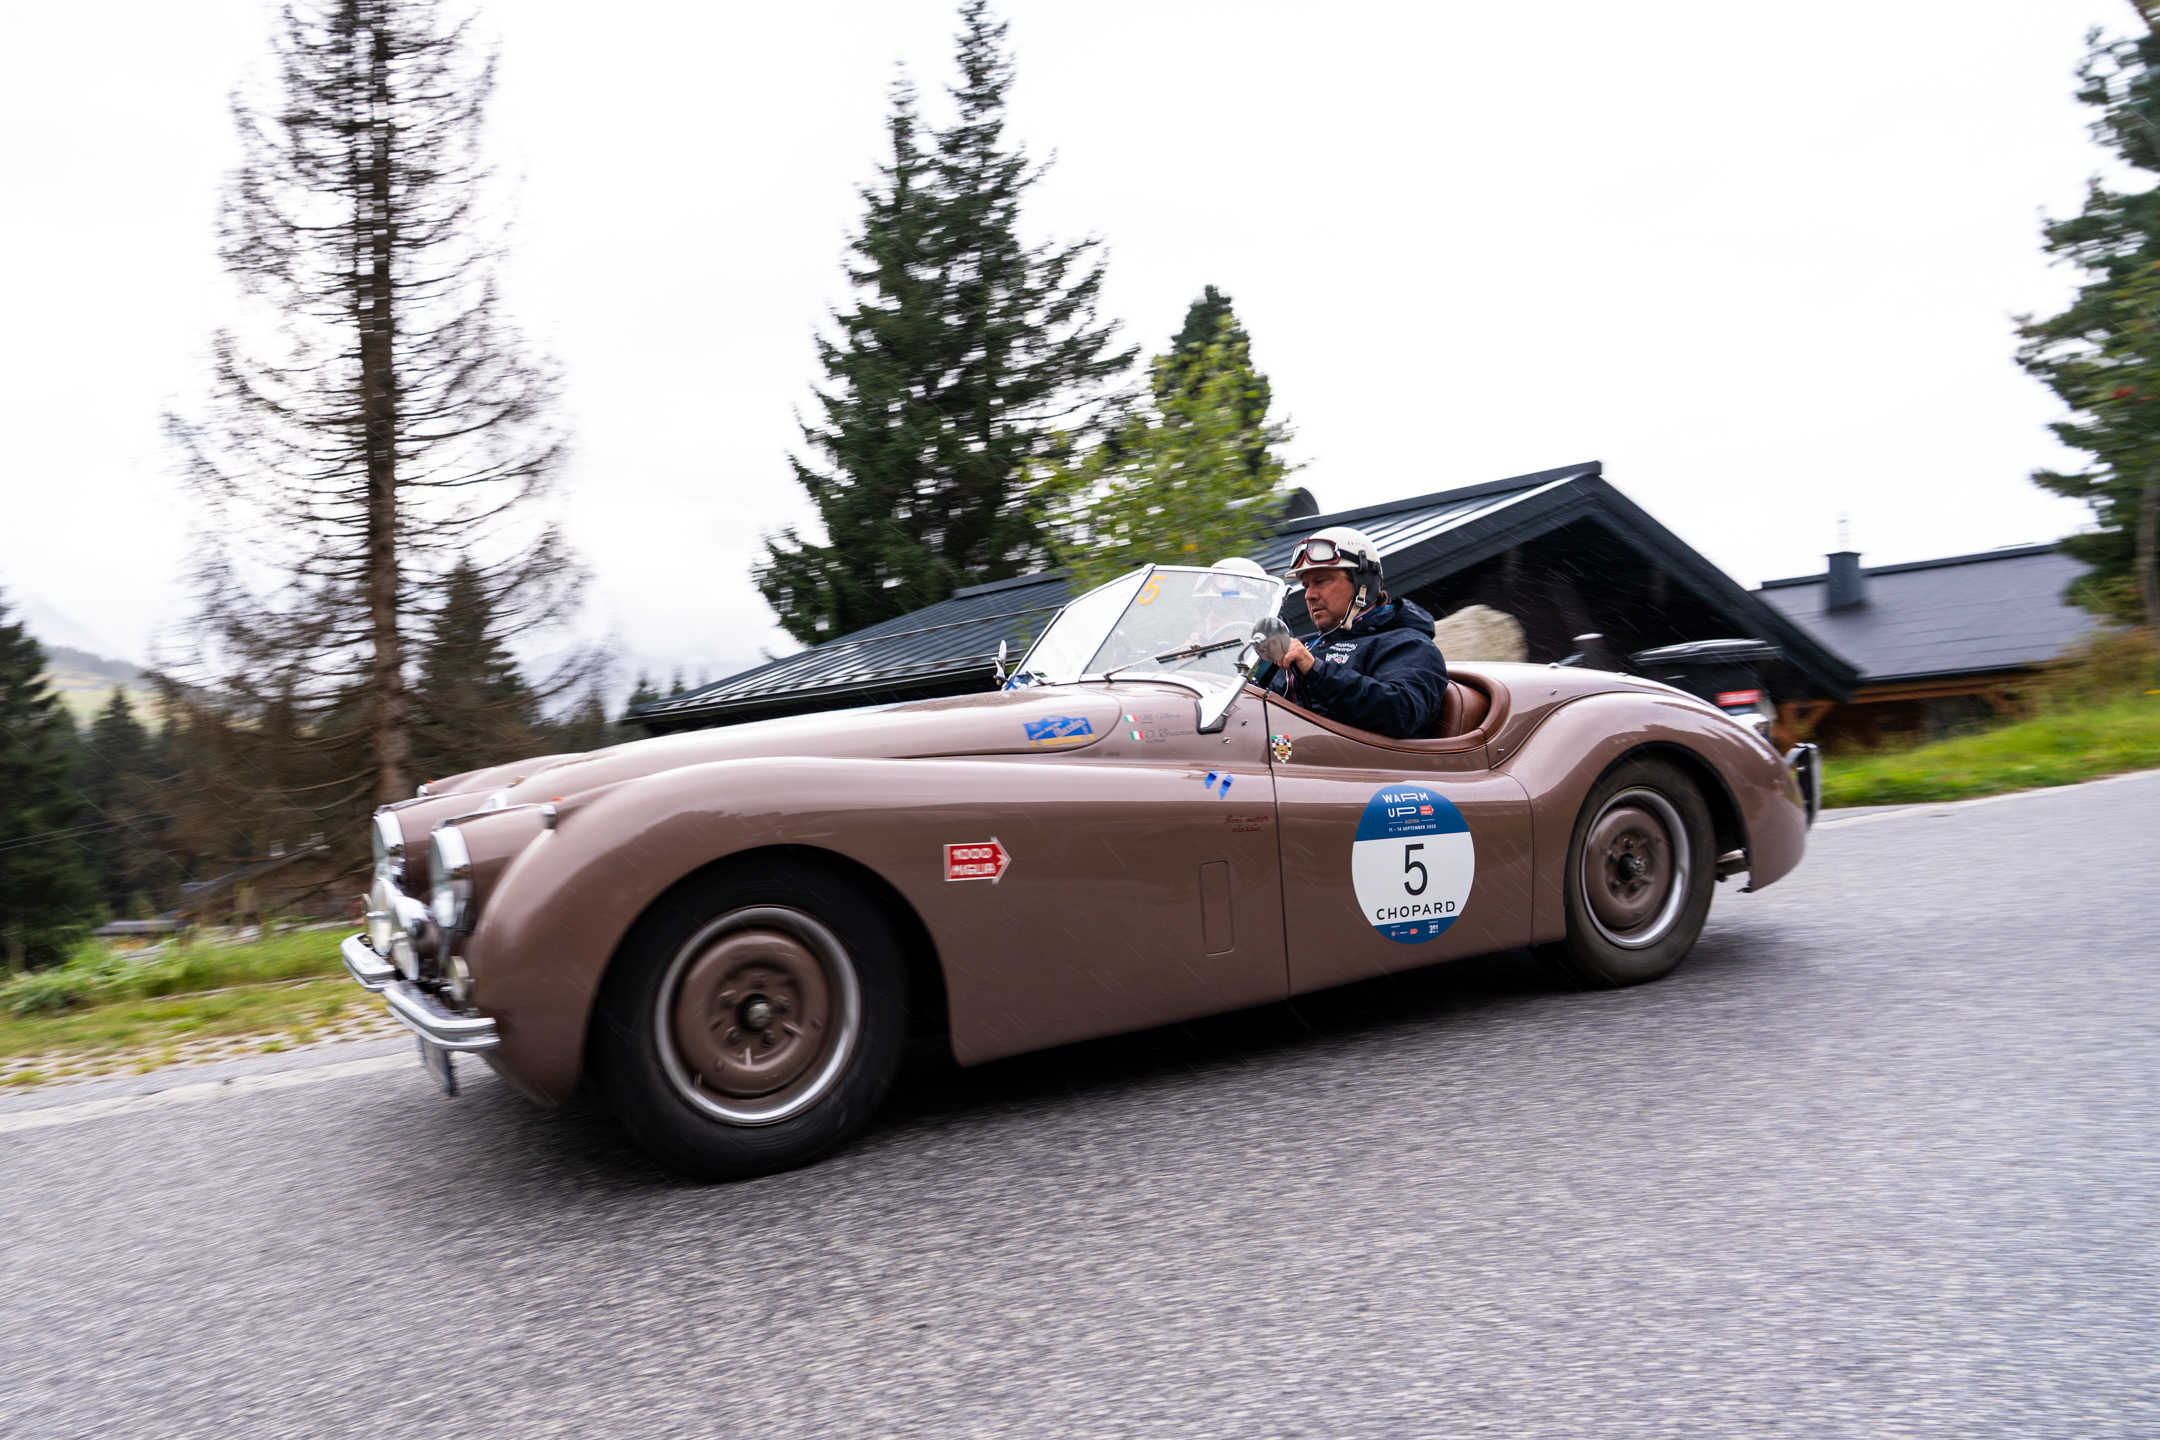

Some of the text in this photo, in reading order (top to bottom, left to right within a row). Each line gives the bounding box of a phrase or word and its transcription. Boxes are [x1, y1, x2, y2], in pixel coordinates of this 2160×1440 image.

[1137, 574, 1168, 605] 5
[1382, 792, 1429, 803] WARM
[1387, 806, 1417, 818] UP
[951, 847, 994, 860] 1000
[1404, 843, 1428, 896] 5
[1376, 900, 1456, 921] CHOPARD
